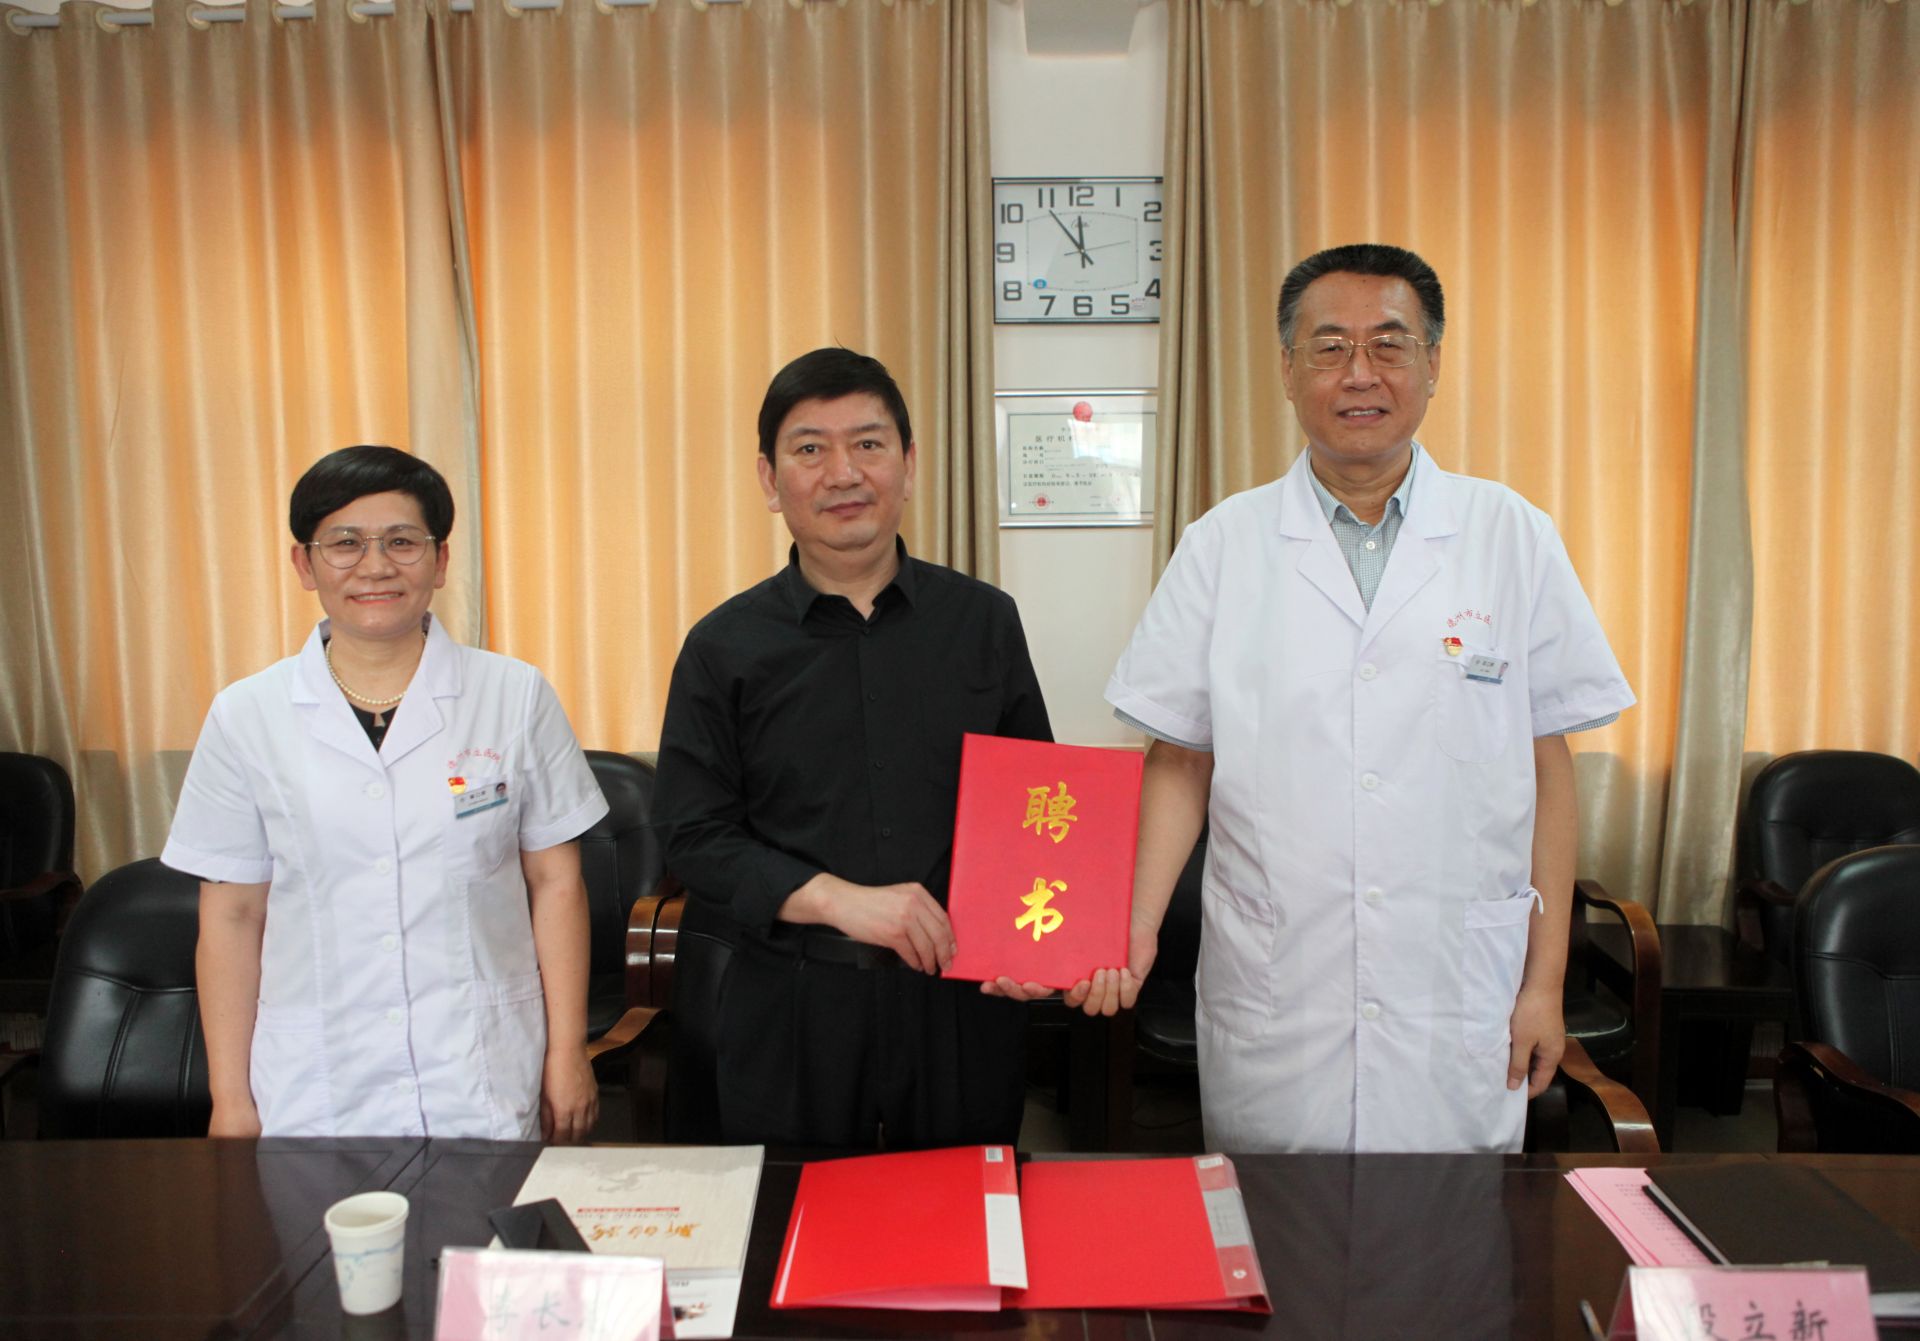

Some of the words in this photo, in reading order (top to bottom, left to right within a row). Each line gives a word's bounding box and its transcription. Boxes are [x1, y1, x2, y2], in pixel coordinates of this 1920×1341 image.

[1038, 187, 1055, 208] 11
[1069, 185, 1094, 207] 12
[1115, 186, 1121, 207] 1
[1000, 203, 1023, 224] 10
[1143, 201, 1162, 222] 2
[996, 242, 1015, 263] 9
[1003, 280, 1022, 301] 8
[1144, 278, 1161, 299] 4
[1038, 295, 1056, 316] 7
[1073, 295, 1093, 316] 6
[1110, 294, 1130, 315] 5
[1014, 781, 1078, 942] 聘书
